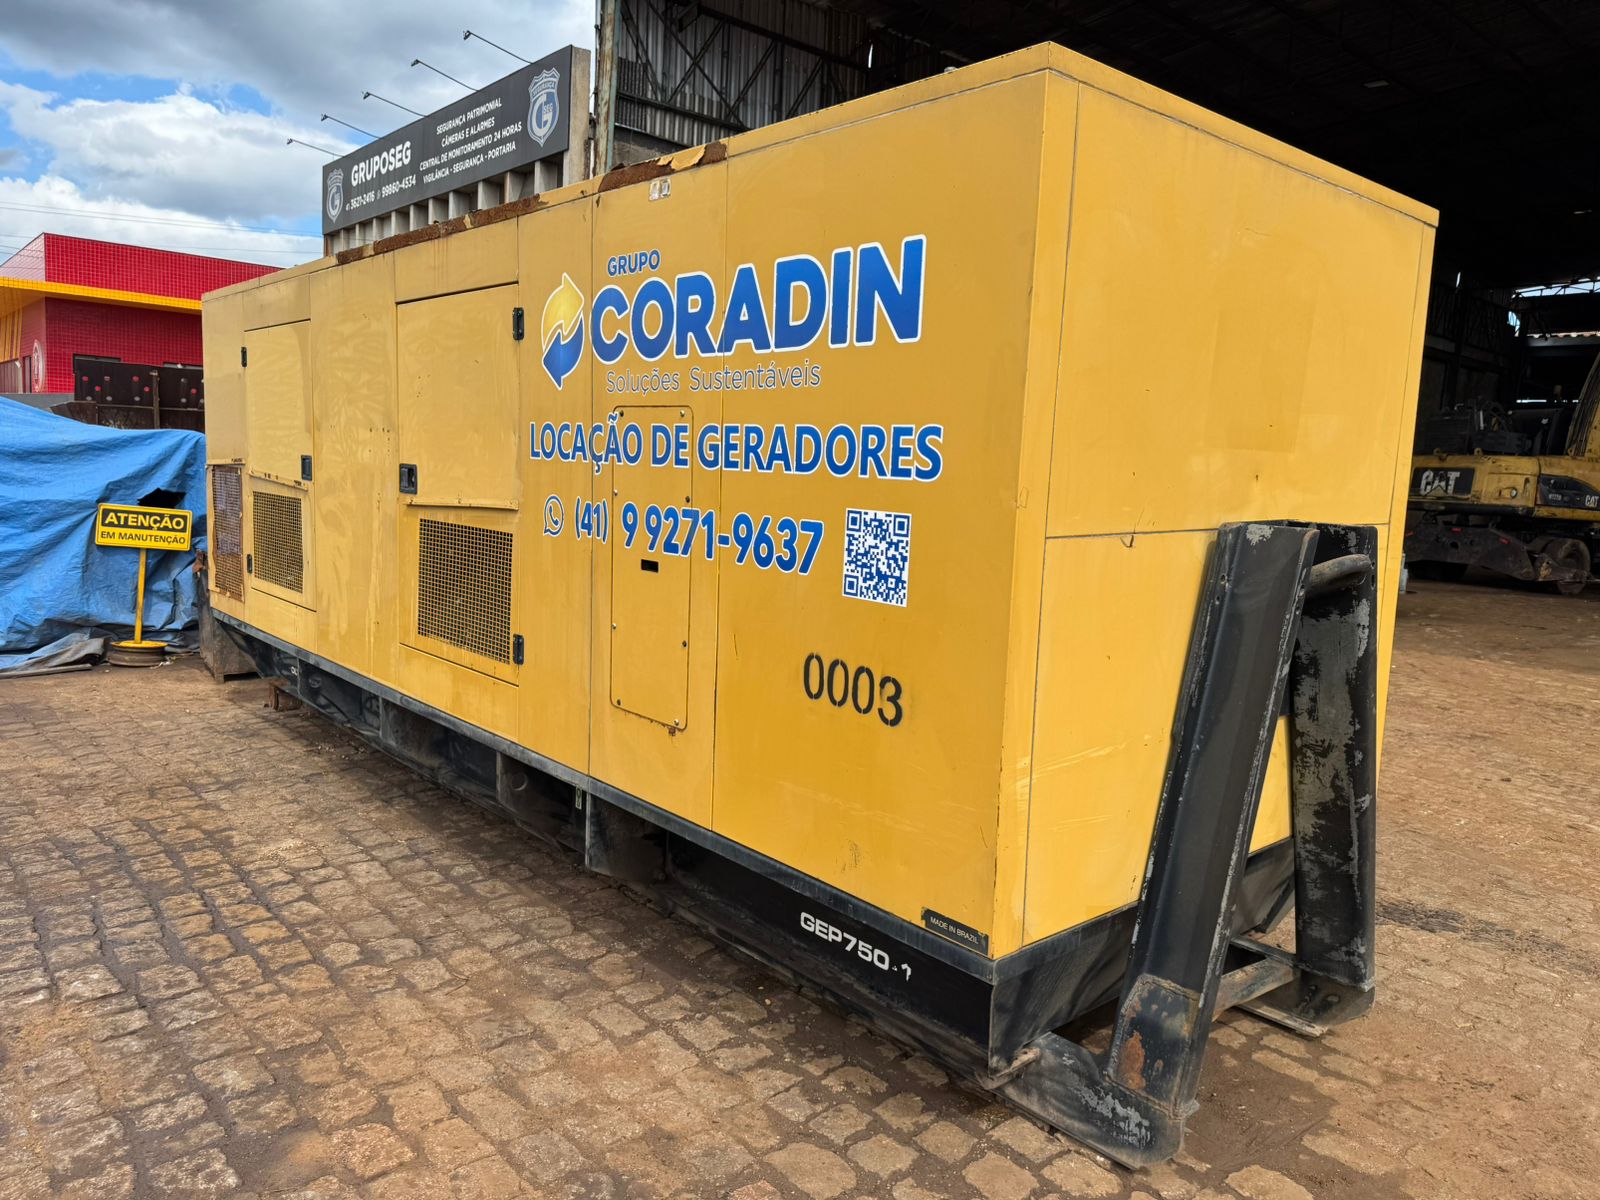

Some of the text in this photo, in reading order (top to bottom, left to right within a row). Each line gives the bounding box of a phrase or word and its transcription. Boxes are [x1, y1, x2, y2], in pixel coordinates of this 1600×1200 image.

[436, 97, 502, 135] SEGURANÇA PATRIMONIAL
[441, 116, 495, 147] CÂMERAS E ALARMES
[351, 141, 411, 187] GRUPOSEG
[419, 121, 523, 171] CENTRAL DE MONITORAMENTO 24 HORAS
[423, 141, 516, 184] VIGILÂNCIA SEGURANÇA PORTARIA
[607, 249, 661, 277] GRUPO
[590, 234, 927, 365] CORADIN
[605, 359, 821, 396] Soluções Sustentáveis
[529, 412, 944, 482] LOCAÇÃO DE GERADORES
[1585, 495, 1599, 507] CAT
[101, 531, 186, 545] EM MANUTENÇÃO
[104, 512, 185, 531] ATENÇÃO
[575, 497, 825, 576] (41) 9 9271-9637
[803, 652, 903, 727] 0003
[930, 916, 979, 945] MADE IN BRAZIL
